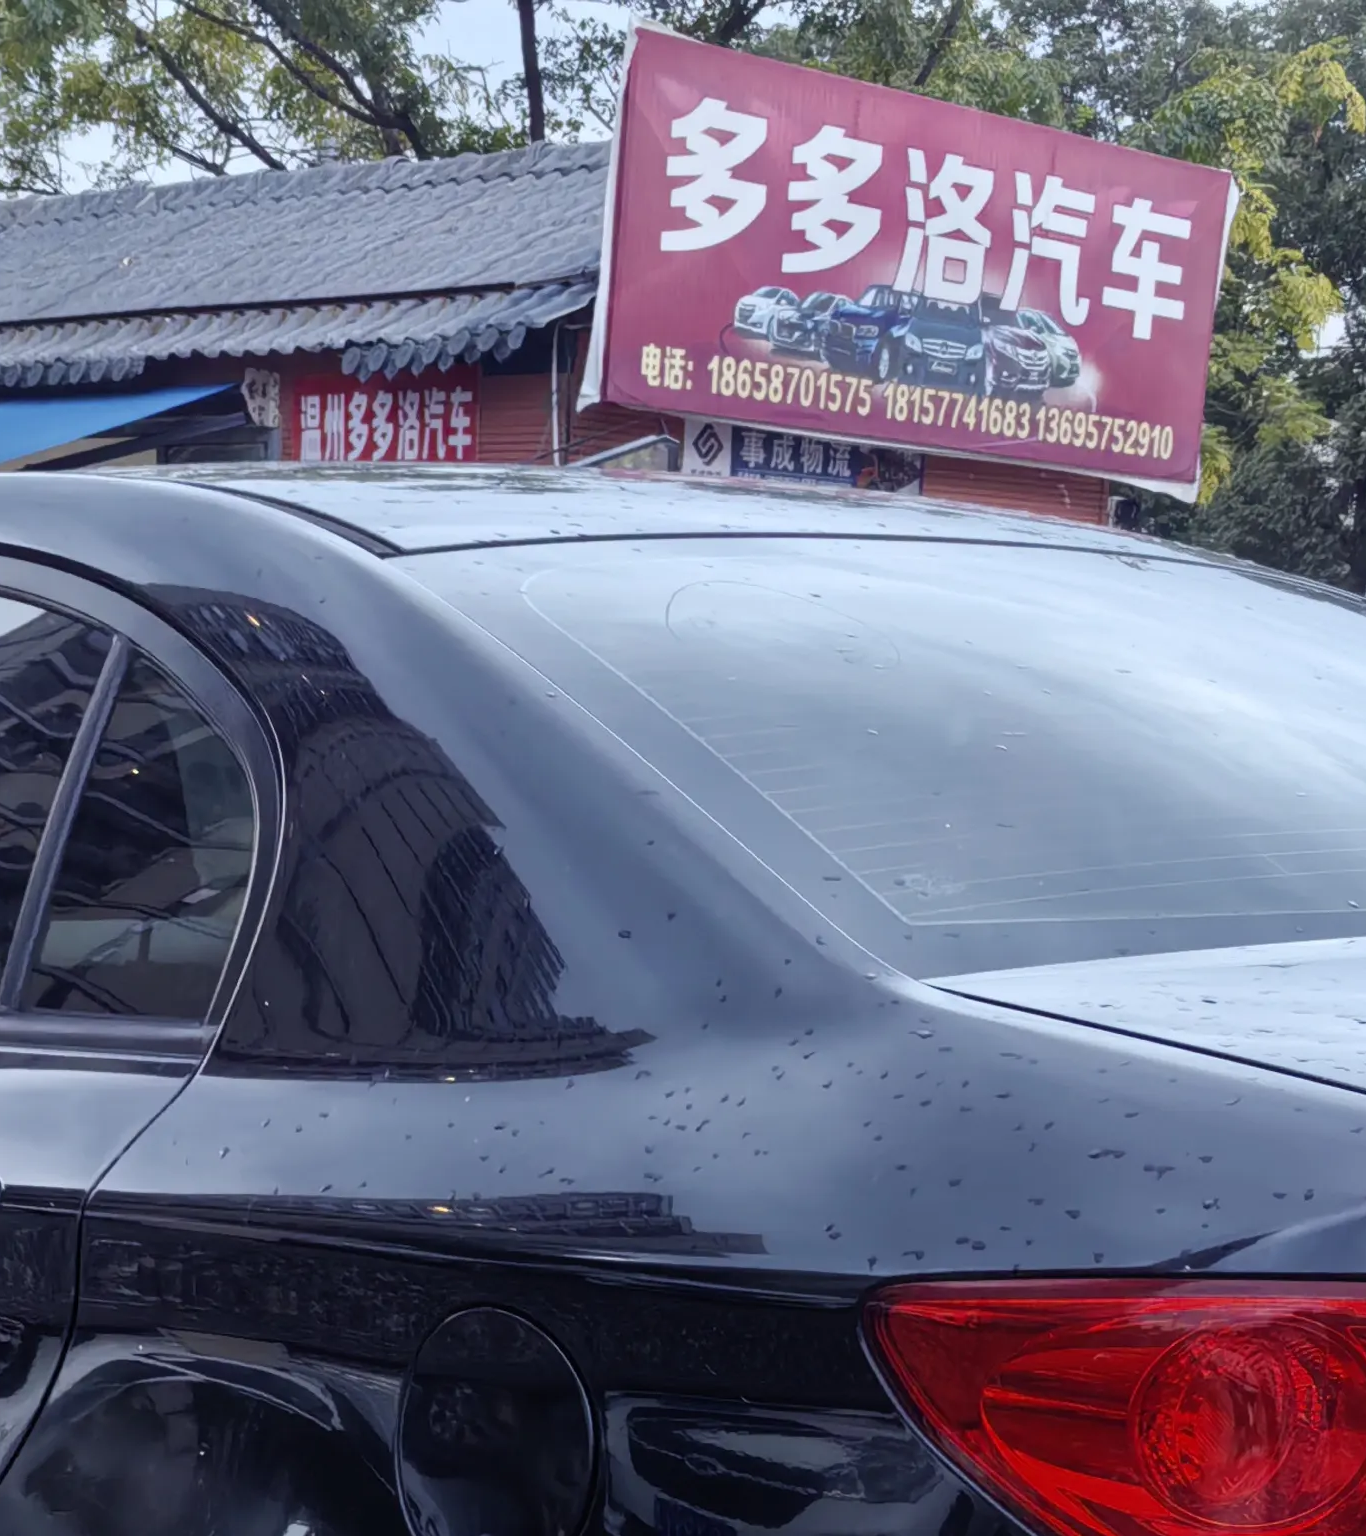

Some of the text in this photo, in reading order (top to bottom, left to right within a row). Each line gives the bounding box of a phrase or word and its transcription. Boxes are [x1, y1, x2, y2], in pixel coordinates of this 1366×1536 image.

[660, 97, 1192, 341] 多多洛汽车
[301, 386, 473, 461] 温州多多洛汽车
[707, 355, 873, 416] 18658701575
[883, 377, 1032, 440] 18157741683
[1035, 406, 1174, 460] 13695752910
[739, 430, 852, 477] 事成物流
